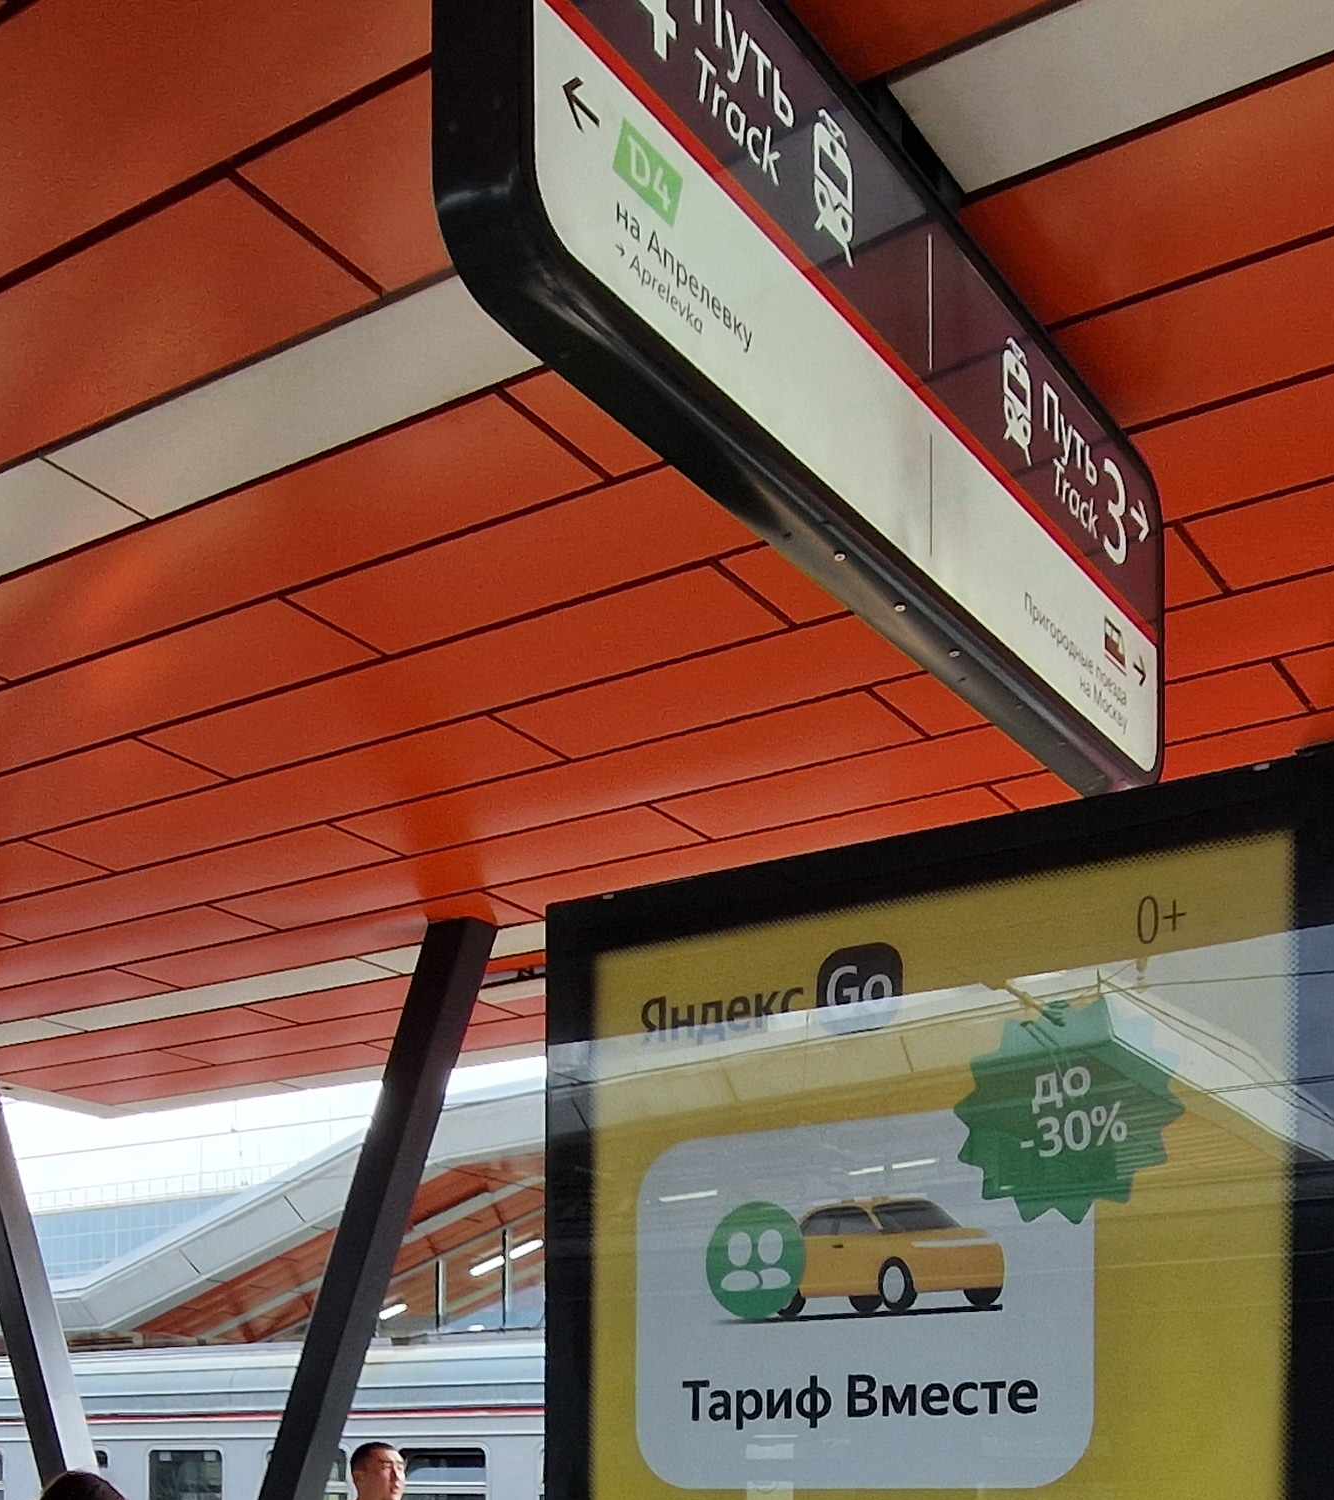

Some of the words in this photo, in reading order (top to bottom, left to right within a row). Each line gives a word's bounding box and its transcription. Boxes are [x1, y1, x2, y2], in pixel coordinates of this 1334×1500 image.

[694, 48, 781, 186] Track
[628, 134, 671, 213] D4
[617, 200, 641, 241] на
[647, 229, 753, 353] Апрелевку
[629, 255, 703, 335] Aprelevka
[1043, 380, 1097, 486] Путь
[1103, 458, 1126, 565] 3
[1052, 456, 1099, 540] Track
[1136, 895, 1187, 944] 0+
[640, 986, 804, 1045] Яндекс
[826, 964, 894, 1010] Go
[1032, 1065, 1092, 1114] до
[1020, 1101, 1128, 1158] -30%
[682, 1375, 832, 1430] Тариф
[847, 1373, 1039, 1418] Вместе
